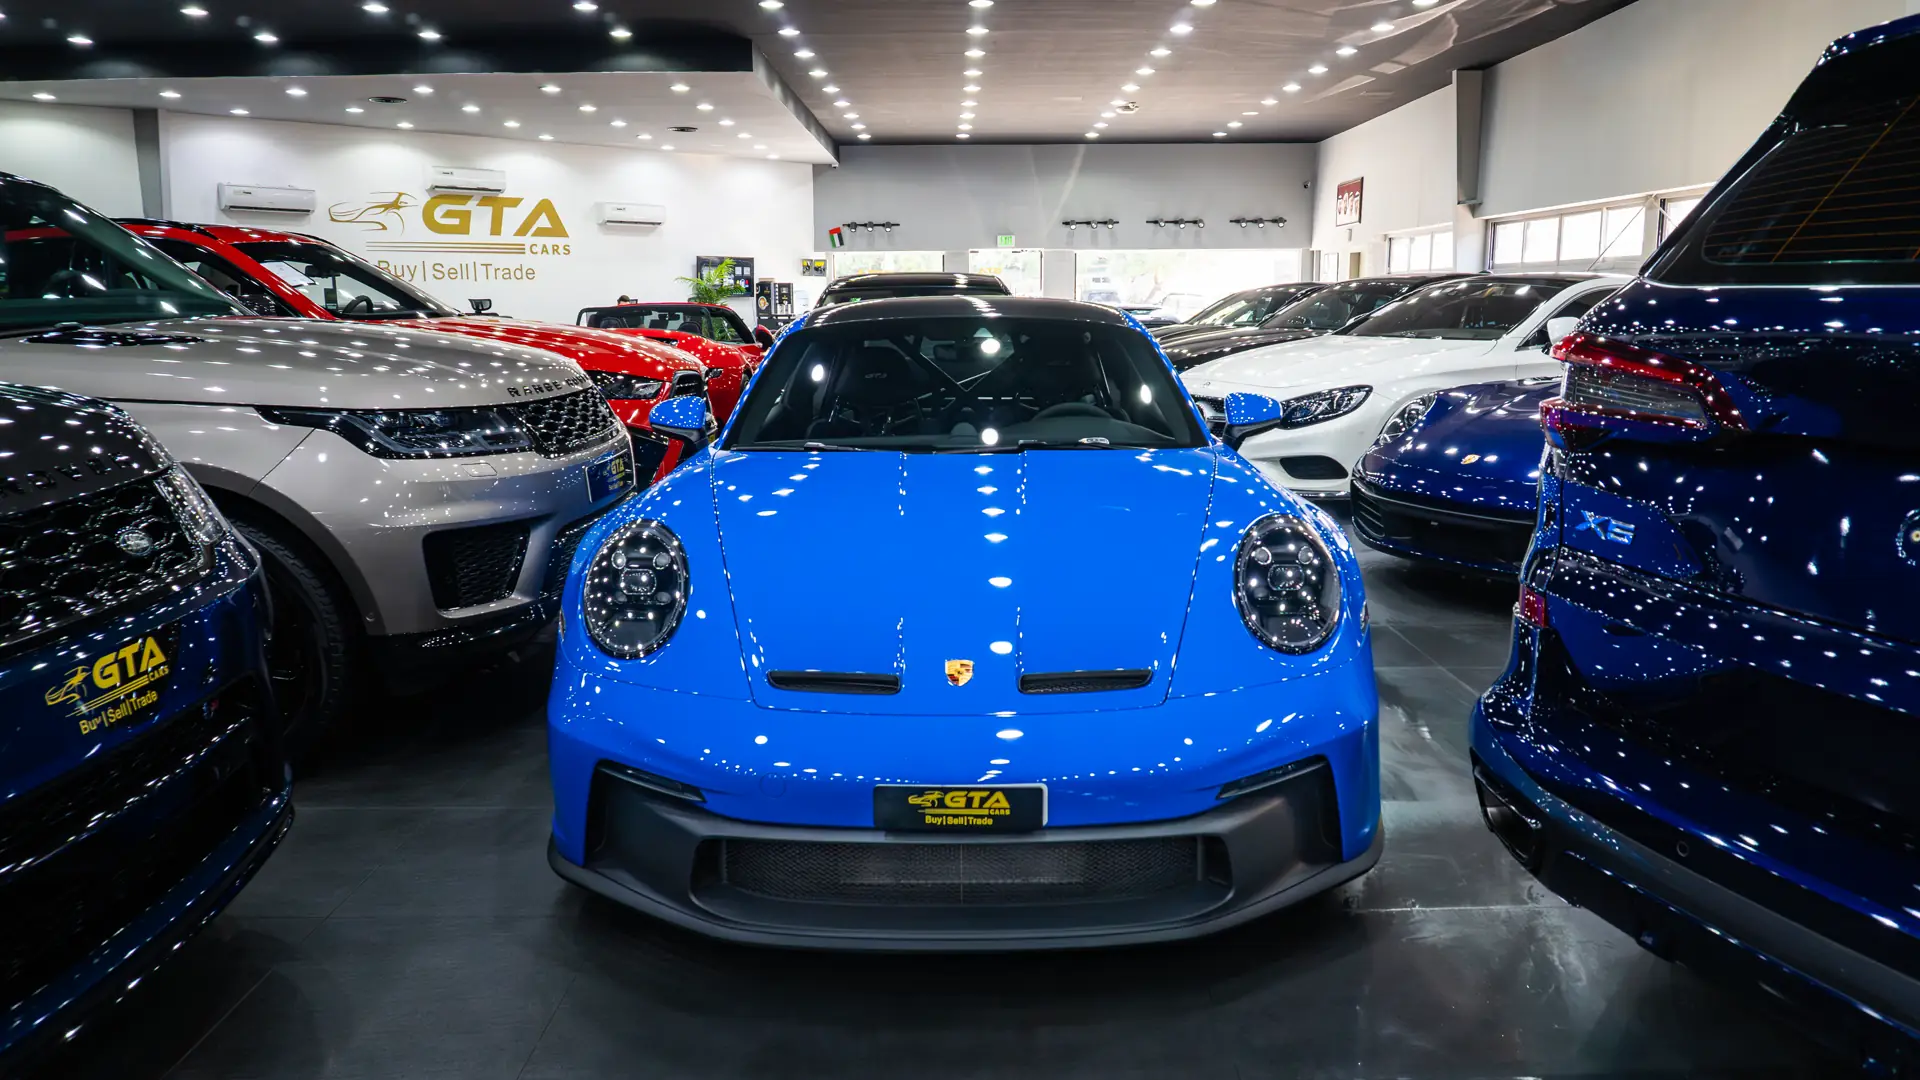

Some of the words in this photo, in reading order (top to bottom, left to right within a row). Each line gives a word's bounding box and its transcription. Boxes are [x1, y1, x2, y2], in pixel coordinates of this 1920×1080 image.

[422, 194, 570, 238] GTA
[529, 243, 571, 256] CARS
[506, 380, 563, 398] RANGE
[1575, 509, 1636, 546] X6
[92, 636, 167, 690] GTA
[147, 665, 170, 682] CARS
[944, 791, 1010, 808] GTA
